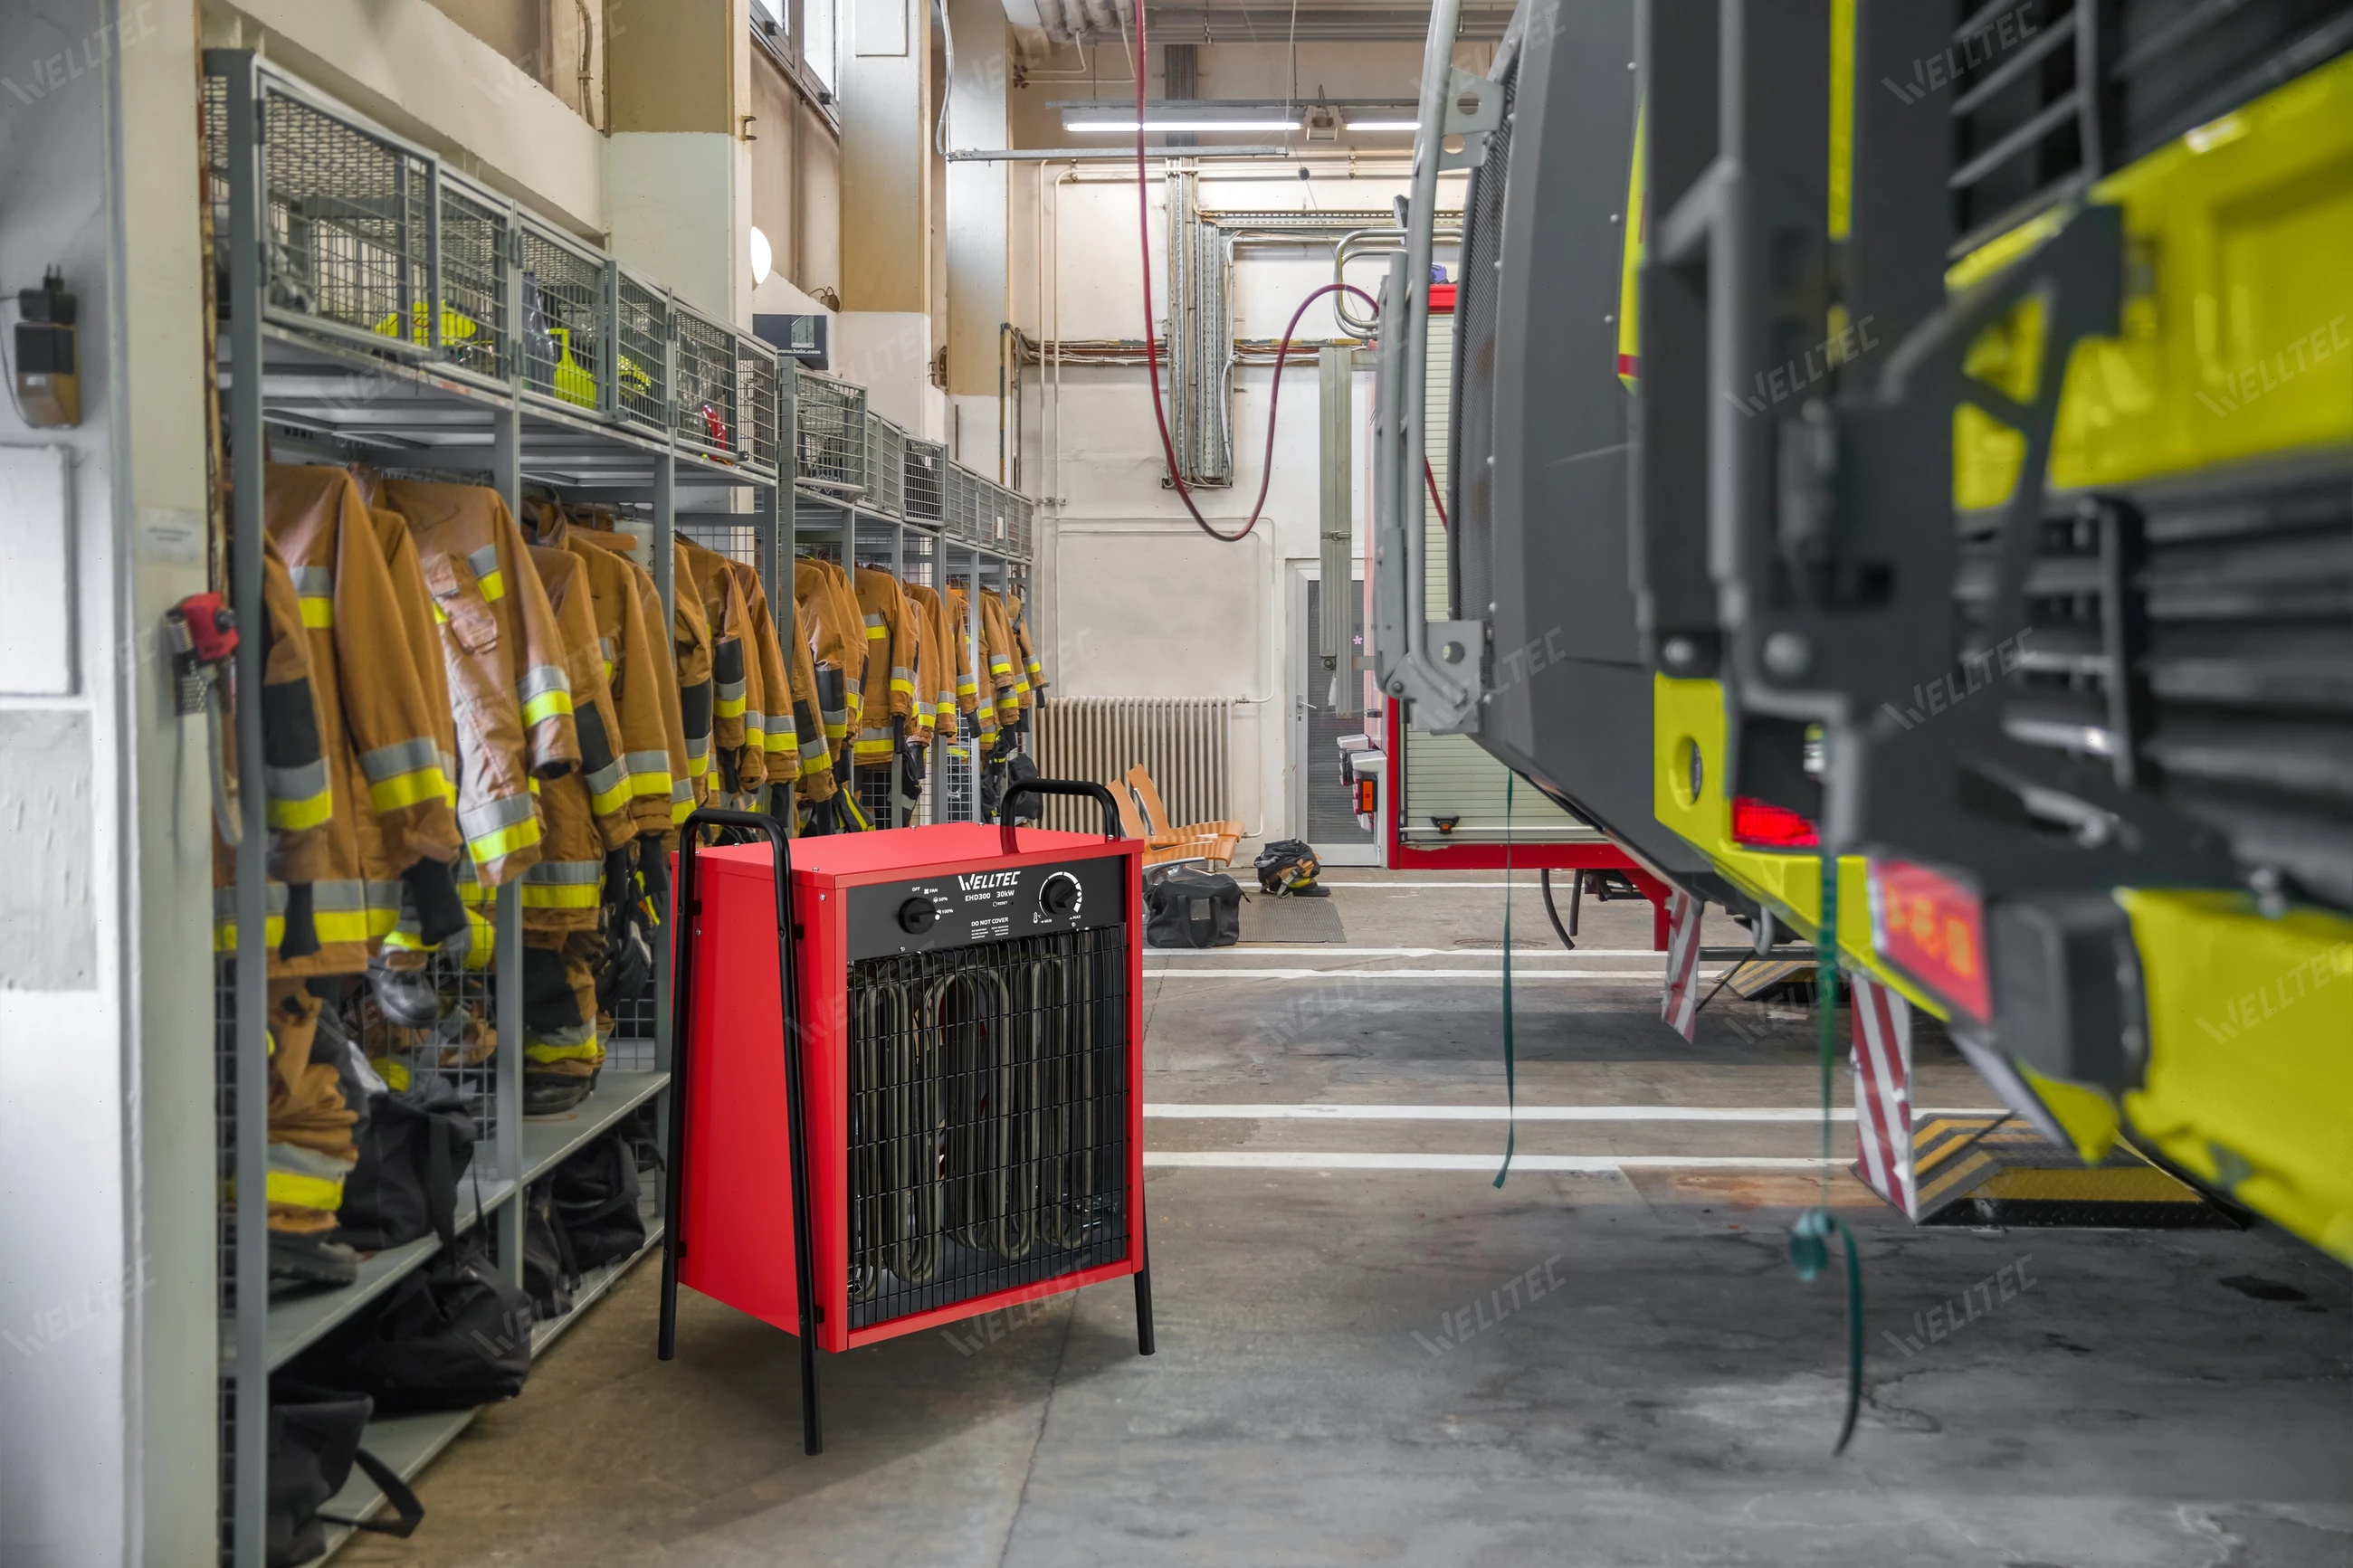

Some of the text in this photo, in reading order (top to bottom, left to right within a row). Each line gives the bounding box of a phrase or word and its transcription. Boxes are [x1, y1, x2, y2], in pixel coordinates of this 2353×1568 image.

[957, 870, 1022, 891] WELLTEC
[965, 889, 1015, 902] EHD300 30kW
